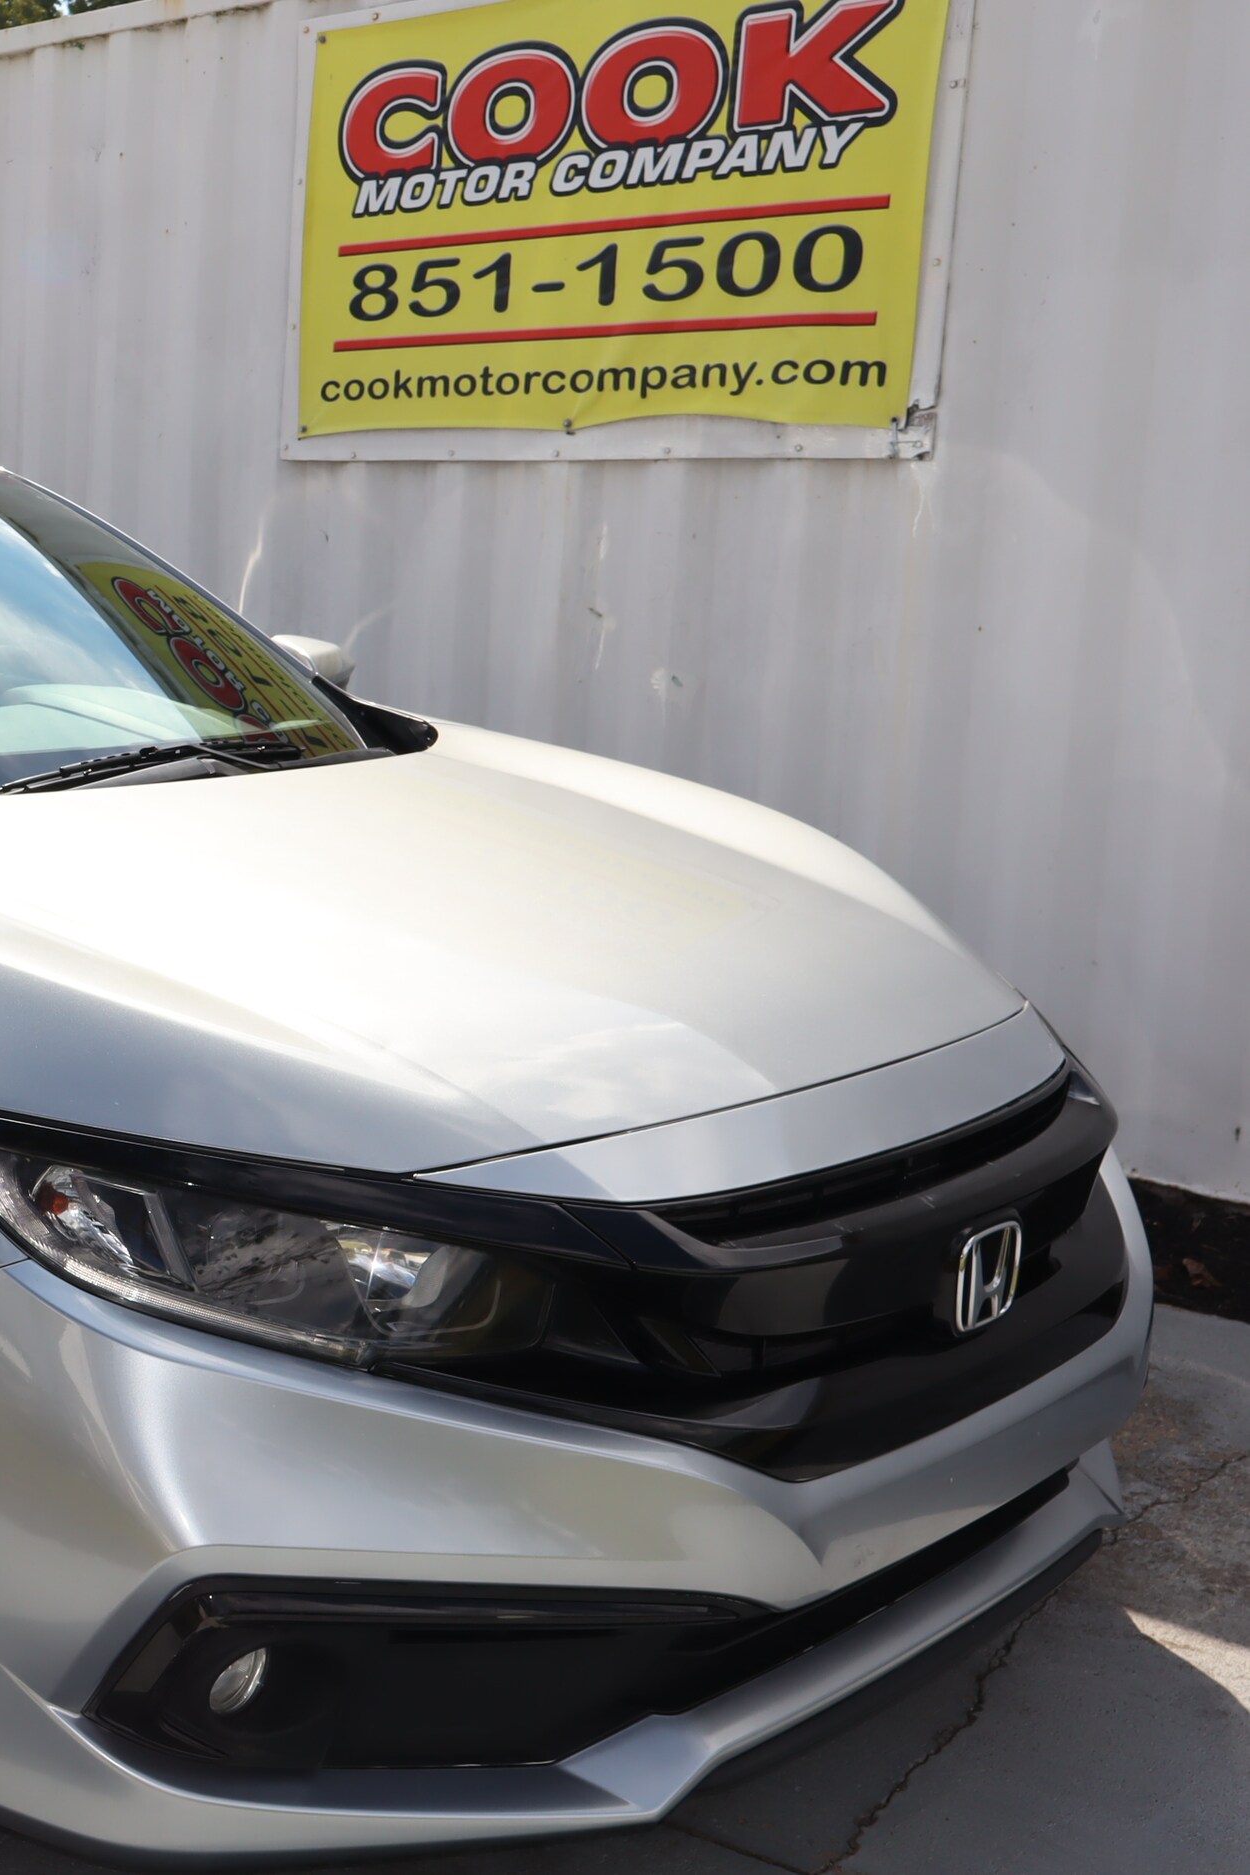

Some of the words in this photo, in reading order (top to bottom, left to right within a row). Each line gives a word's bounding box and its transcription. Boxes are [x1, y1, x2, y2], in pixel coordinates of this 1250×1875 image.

[339, 0, 904, 180] COOK
[353, 160, 537, 215] MOTOR
[551, 121, 864, 194] COMPANY
[347, 223, 864, 322] 851-1500
[320, 357, 887, 402] cookmotorcompany.com
